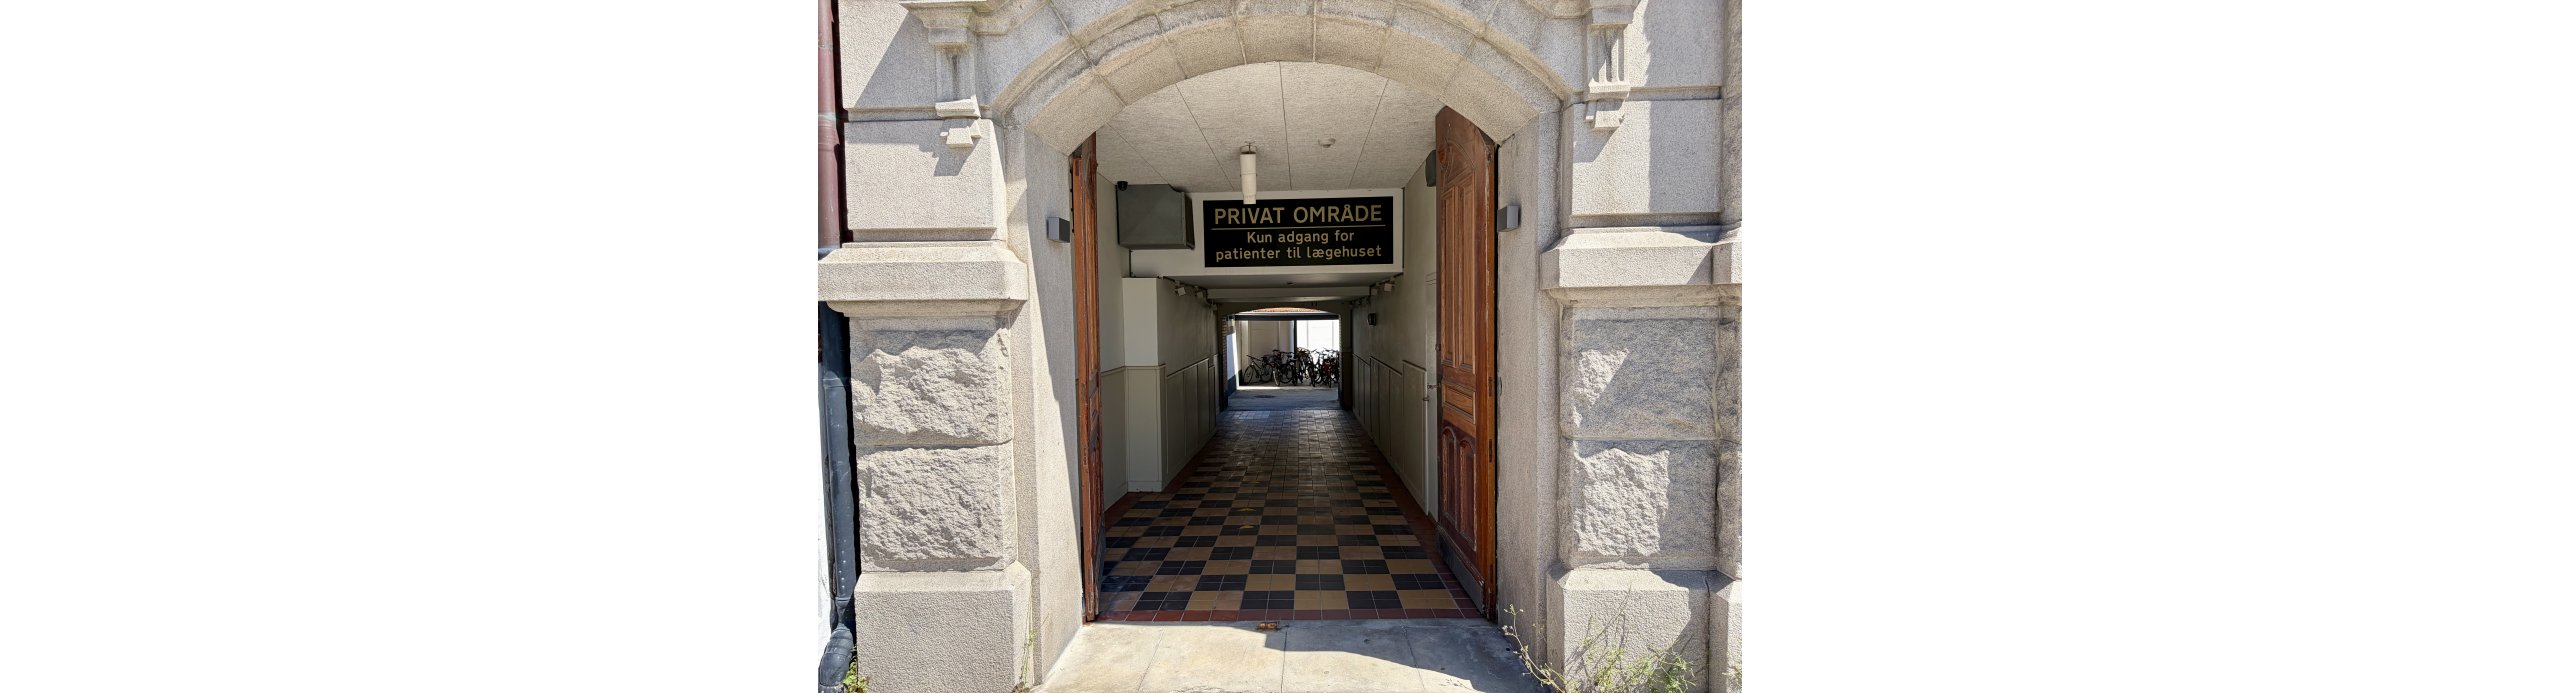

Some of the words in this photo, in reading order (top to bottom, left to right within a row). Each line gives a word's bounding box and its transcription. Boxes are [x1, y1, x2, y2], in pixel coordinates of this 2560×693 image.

[1214, 207, 1285, 225] PRIVAT
[1293, 204, 1382, 223] OMRÅDE
[1247, 232, 1272, 243] Kun
[1278, 230, 1329, 245] adgang
[1334, 230, 1354, 242] for
[1216, 248, 1280, 262] patienter
[1286, 247, 1301, 259] til
[1307, 245, 1382, 260] lægehuset
